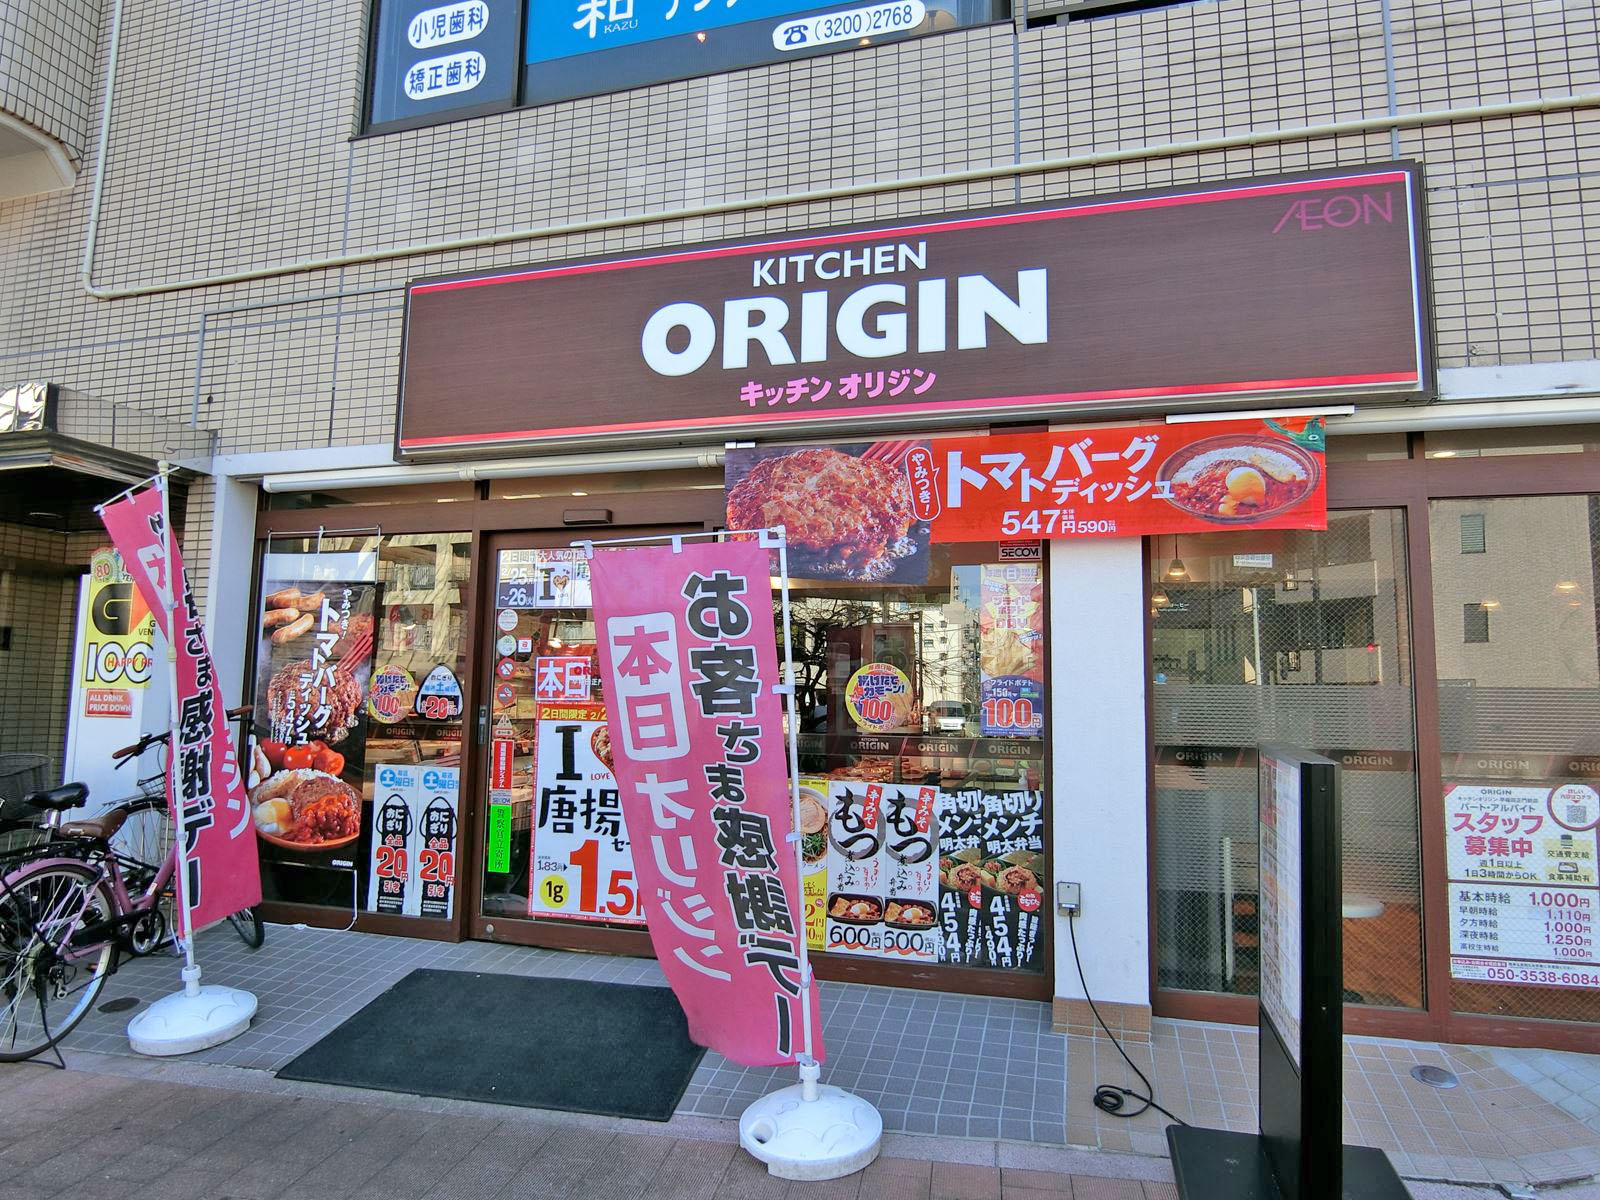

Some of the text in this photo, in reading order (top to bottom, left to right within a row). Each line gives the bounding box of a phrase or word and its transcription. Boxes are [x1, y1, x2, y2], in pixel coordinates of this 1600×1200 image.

[413, 5, 483, 43] 小児歯科
[604, 19, 638, 34] KAZU
[814, 5, 913, 41] (3200)2768
[409, 56, 480, 94] 矯正歯科
[752, 241, 927, 287] KITCHEN
[641, 268, 1048, 377] ORIGIN
[740, 368, 936, 407] キッチン オリジン
[947, 434, 1160, 508] トマトバーグ
[1051, 475, 1176, 505] ディッシュ
[1001, 547, 1039, 557] SECOM
[312, 598, 341, 729] トマトバーグ
[539, 660, 591, 697] 本日
[89, 694, 102, 702] ALL
[89, 703, 132, 712] PRICE DOWN
[541, 707, 588, 720] 2日間限定
[555, 725, 582, 781] I
[850, 741, 890, 751] ORIGIN
[918, 743, 959, 753] ORIGIN
[988, 744, 1031, 755] ORIGIN
[1175, 751, 1223, 762] ORIGIN
[1342, 755, 1393, 766] ORIGIN
[1477, 760, 1530, 770] ORIGIN
[591, 773, 611, 781] LOVE
[538, 785, 622, 836] 唐揚
[863, 788, 880, 826] 辛みそ
[917, 791, 933, 830] 辛みそ
[981, 789, 1042, 818] 角切り
[835, 786, 880, 859] もつ
[886, 789, 933, 864] もつ
[982, 811, 1043, 840] メンチ
[1452, 812, 1544, 835] スタッフ
[385, 834, 404, 847] 全品
[428, 837, 449, 850] 全品
[986, 835, 1043, 854] 明太弁当
[1464, 835, 1533, 858] 募集中
[1547, 850, 1590, 859] 交通費支給
[1464, 868, 1537, 880] 1日3時間からOK
[383, 880, 401, 894] 引き
[427, 884, 446, 898] 引き
[545, 880, 564, 903] 1g
[1459, 890, 1511, 904] 基本時給
[1459, 906, 1498, 917] 早朝時給
[1459, 918, 1498, 929] 夕方時給
[1460, 930, 1499, 941] 深夜時給
[1487, 967, 1600, 986] 050-3538-6084
